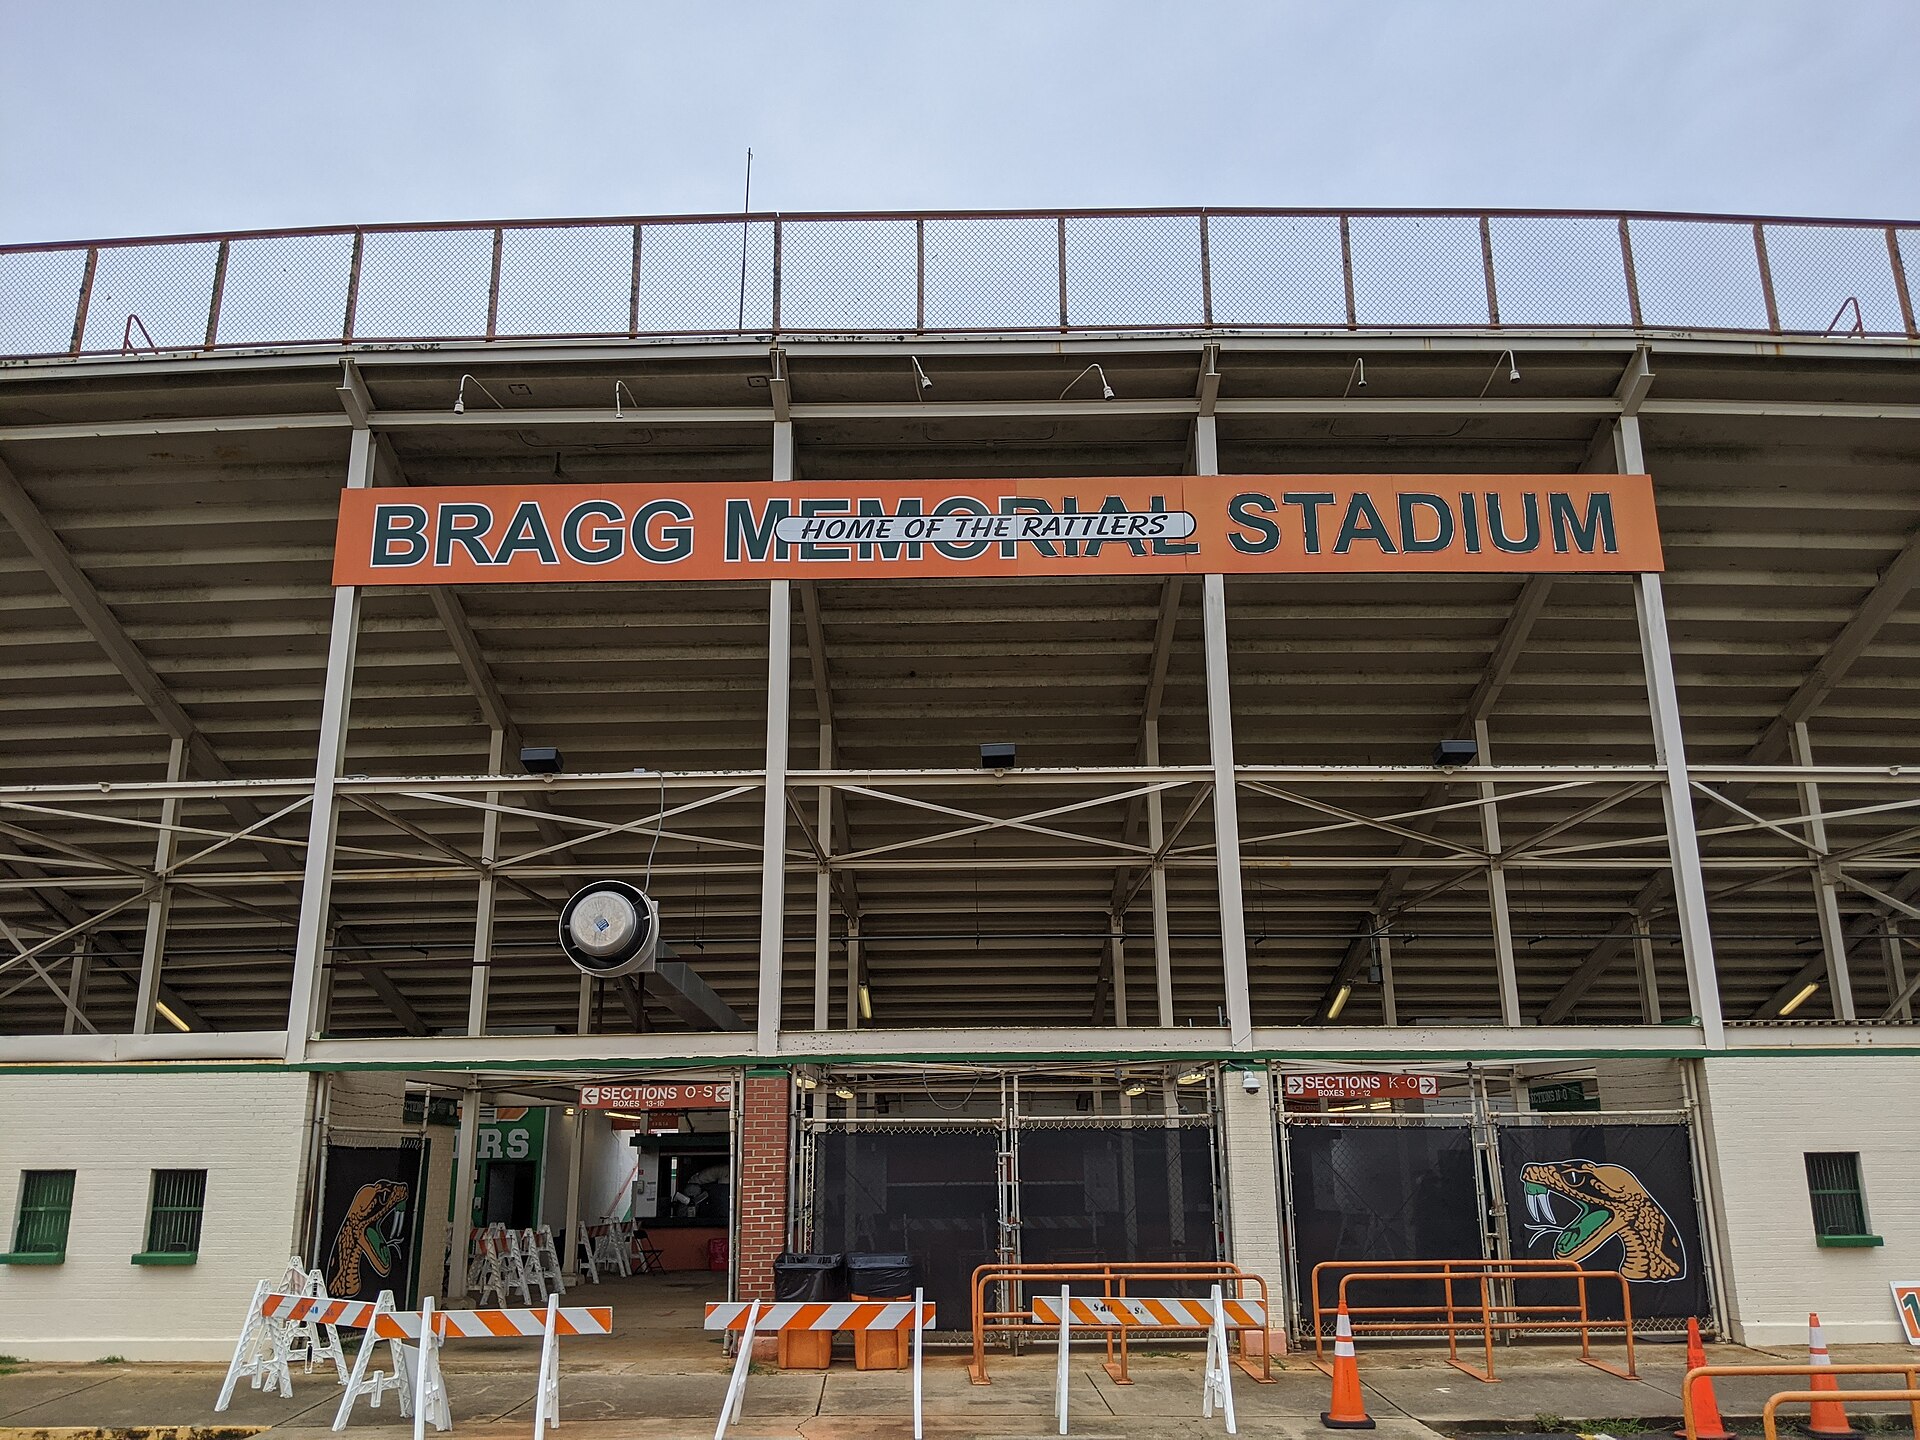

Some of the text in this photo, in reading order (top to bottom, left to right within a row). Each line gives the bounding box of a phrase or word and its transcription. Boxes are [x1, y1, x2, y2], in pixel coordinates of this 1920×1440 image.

[369, 491, 1619, 568] BRAGG MEMORIAL STADIUM
[801, 514, 1169, 539] HOME OF THE RATTLERS
[1304, 1076, 1381, 1089] SECTIONS
[600, 1087, 678, 1100] SECTIONS
[1317, 1089, 1345, 1097] BOXES
[1530, 1090, 1554, 1104] ECTIONS
[453, 1128, 530, 1159] RS
